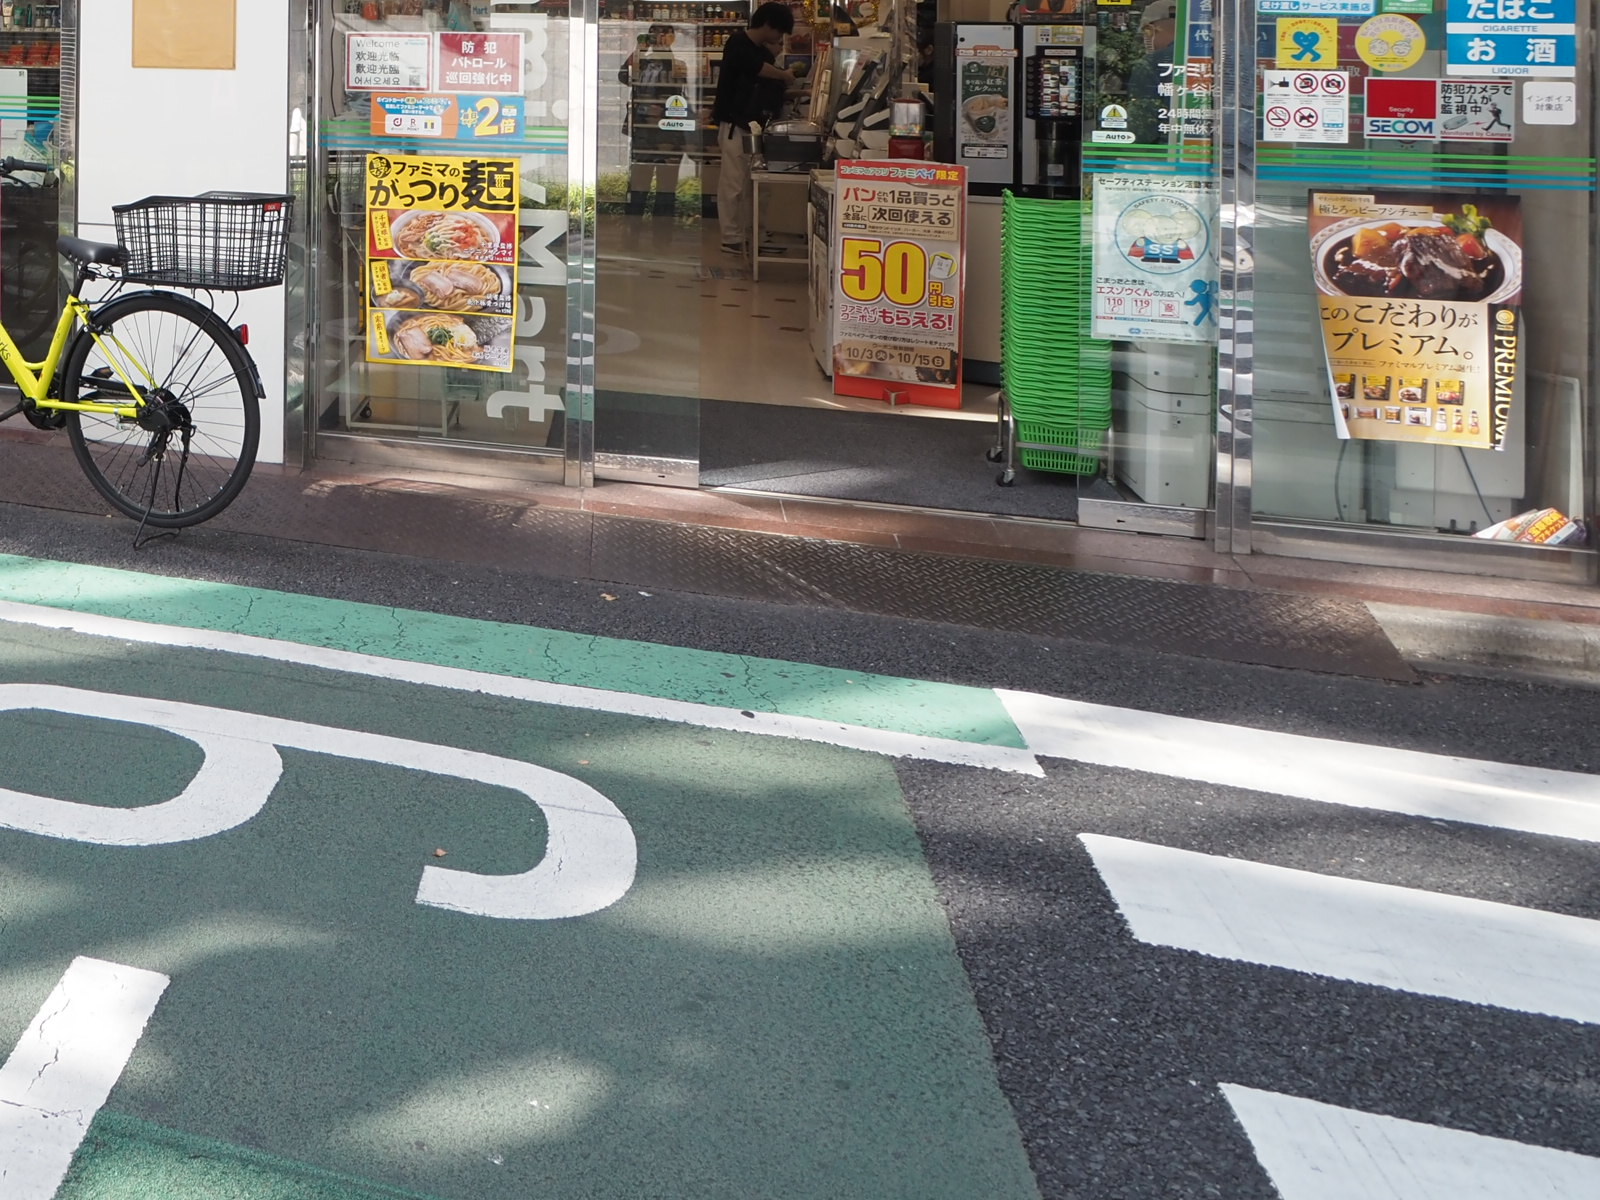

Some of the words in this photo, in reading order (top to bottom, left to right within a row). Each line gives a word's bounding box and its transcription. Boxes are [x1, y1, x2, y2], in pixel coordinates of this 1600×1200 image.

[1302, 2, 1370, 12] サービス実施店
[356, 39, 400, 48] Welcome
[451, 57, 507, 68] パトロール
[354, 76, 400, 85] 어서오세요
[445, 71, 512, 85] 巡回強化中
[1441, 84, 1512, 95] 防犯カメラで
[1442, 95, 1492, 105] セコムが
[1388, 106, 1414, 114] Security
[1441, 104, 1482, 115] 監視中
[1534, 104, 1564, 112] 対象店
[1370, 120, 1433, 134] SECOM
[393, 161, 460, 177] ファミマの
[370, 178, 460, 209] がっつり
[843, 187, 876, 202] パン
[889, 189, 955, 207] 1品買うと
[846, 204, 864, 213] パン
[1133, 197, 1159, 209] SAFETY
[1161, 197, 1189, 210] STATION
[843, 212, 867, 221] 全品に
[872, 207, 952, 226] 次回使える
[1149, 244, 1174, 254] SS
[840, 237, 927, 307] 50
[928, 294, 955, 308] 引き
[1107, 297, 1123, 306] 110
[1133, 299, 1150, 307] 119
[841, 304, 878, 314] ファミペイ
[841, 312, 878, 323] クーポン
[879, 308, 954, 331] もらえる!
[1320, 302, 1478, 330] このこだわりが
[846, 347, 873, 360] 10/3
[897, 351, 930, 366] 10/15
[1493, 334, 1518, 451] PREMIUM
